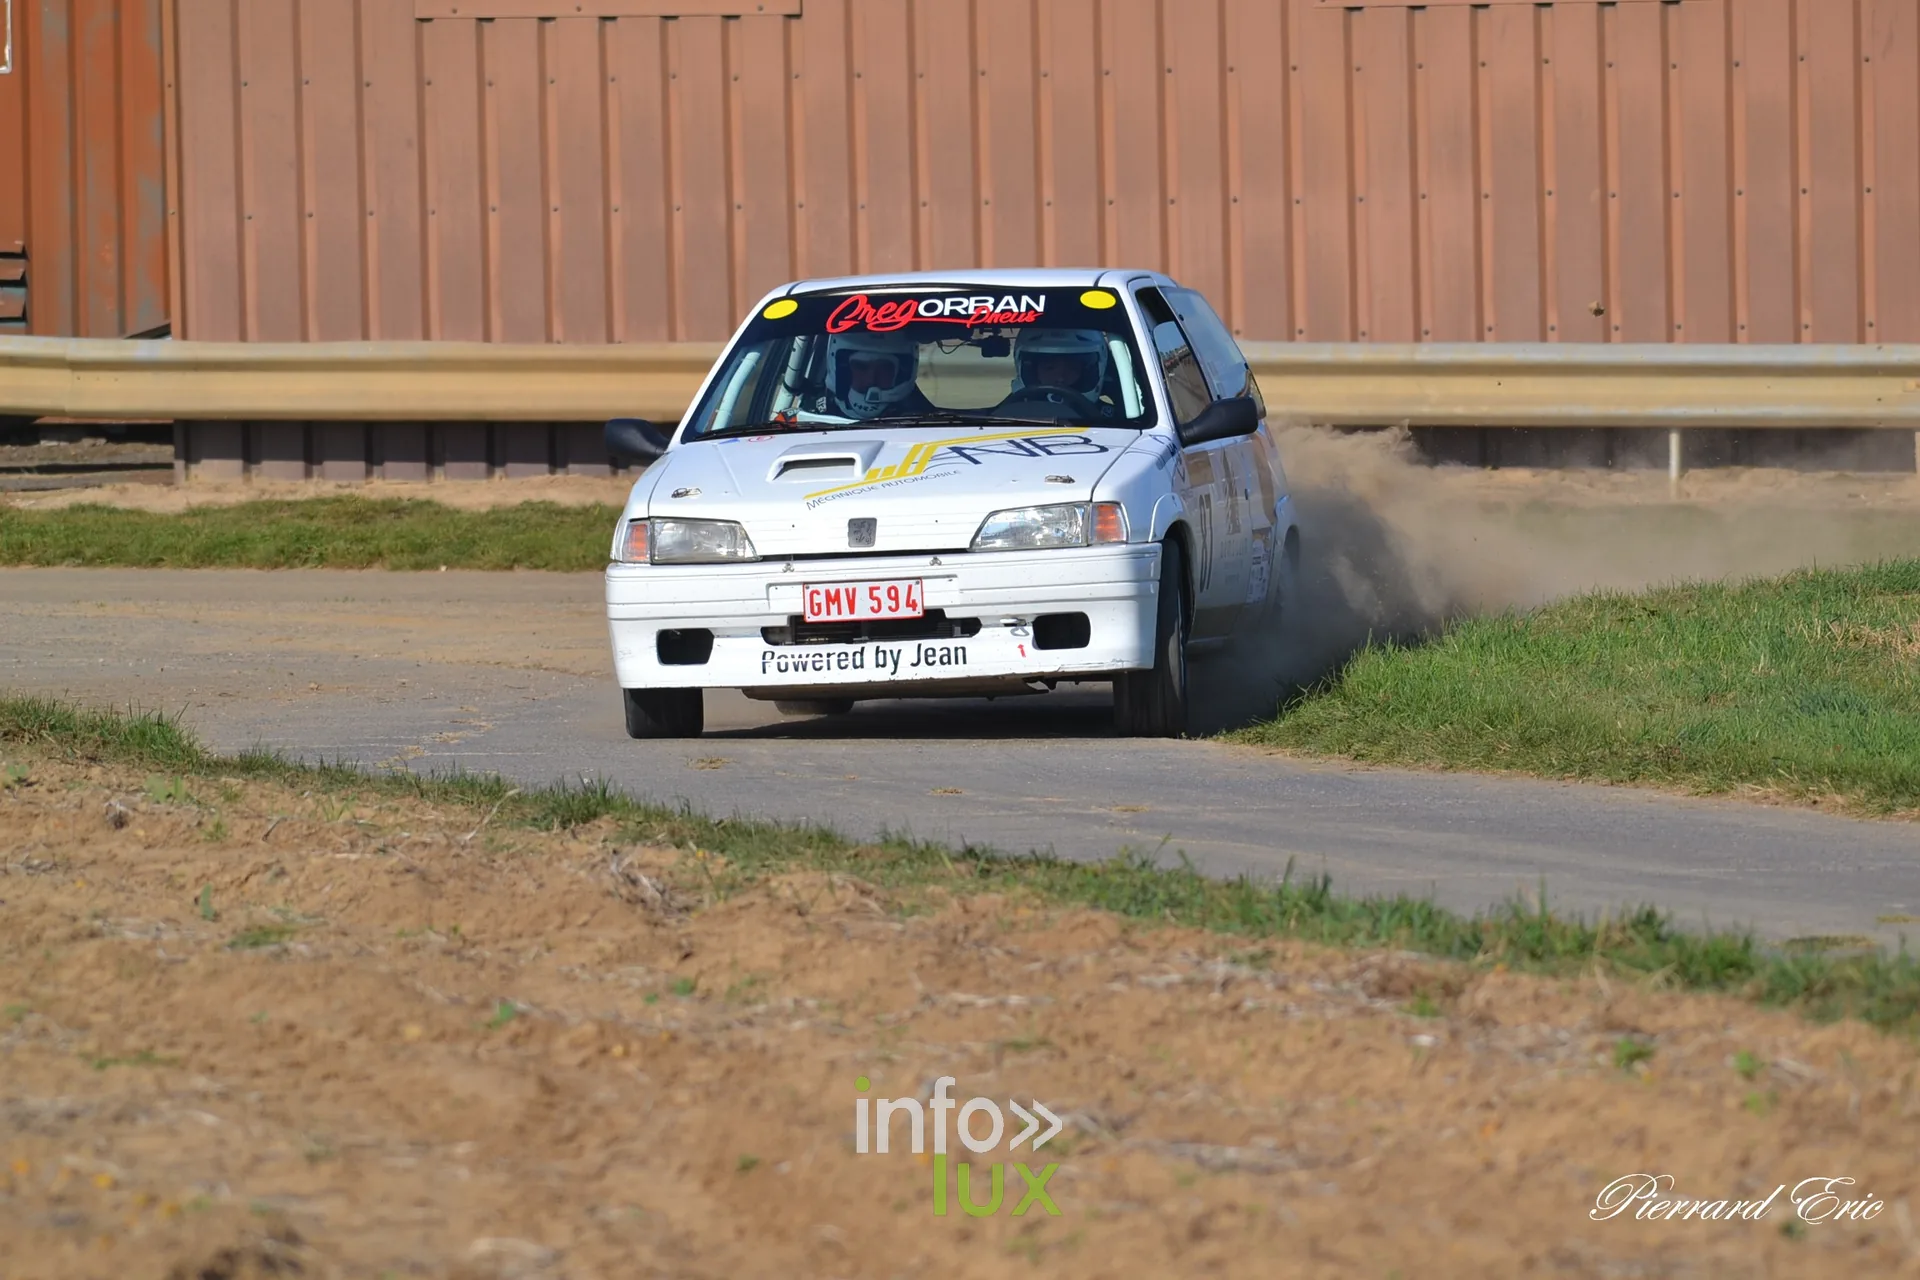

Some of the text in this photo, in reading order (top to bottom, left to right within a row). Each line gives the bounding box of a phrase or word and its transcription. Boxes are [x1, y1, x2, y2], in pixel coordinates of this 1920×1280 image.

[826, 294, 1046, 333] Greg ORBAN
[966, 304, 1044, 329] Pneus
[881, 469, 963, 489] AUTOMOBILE
[808, 584, 919, 617] GMV 594
[761, 643, 968, 675] Powered by Jean
